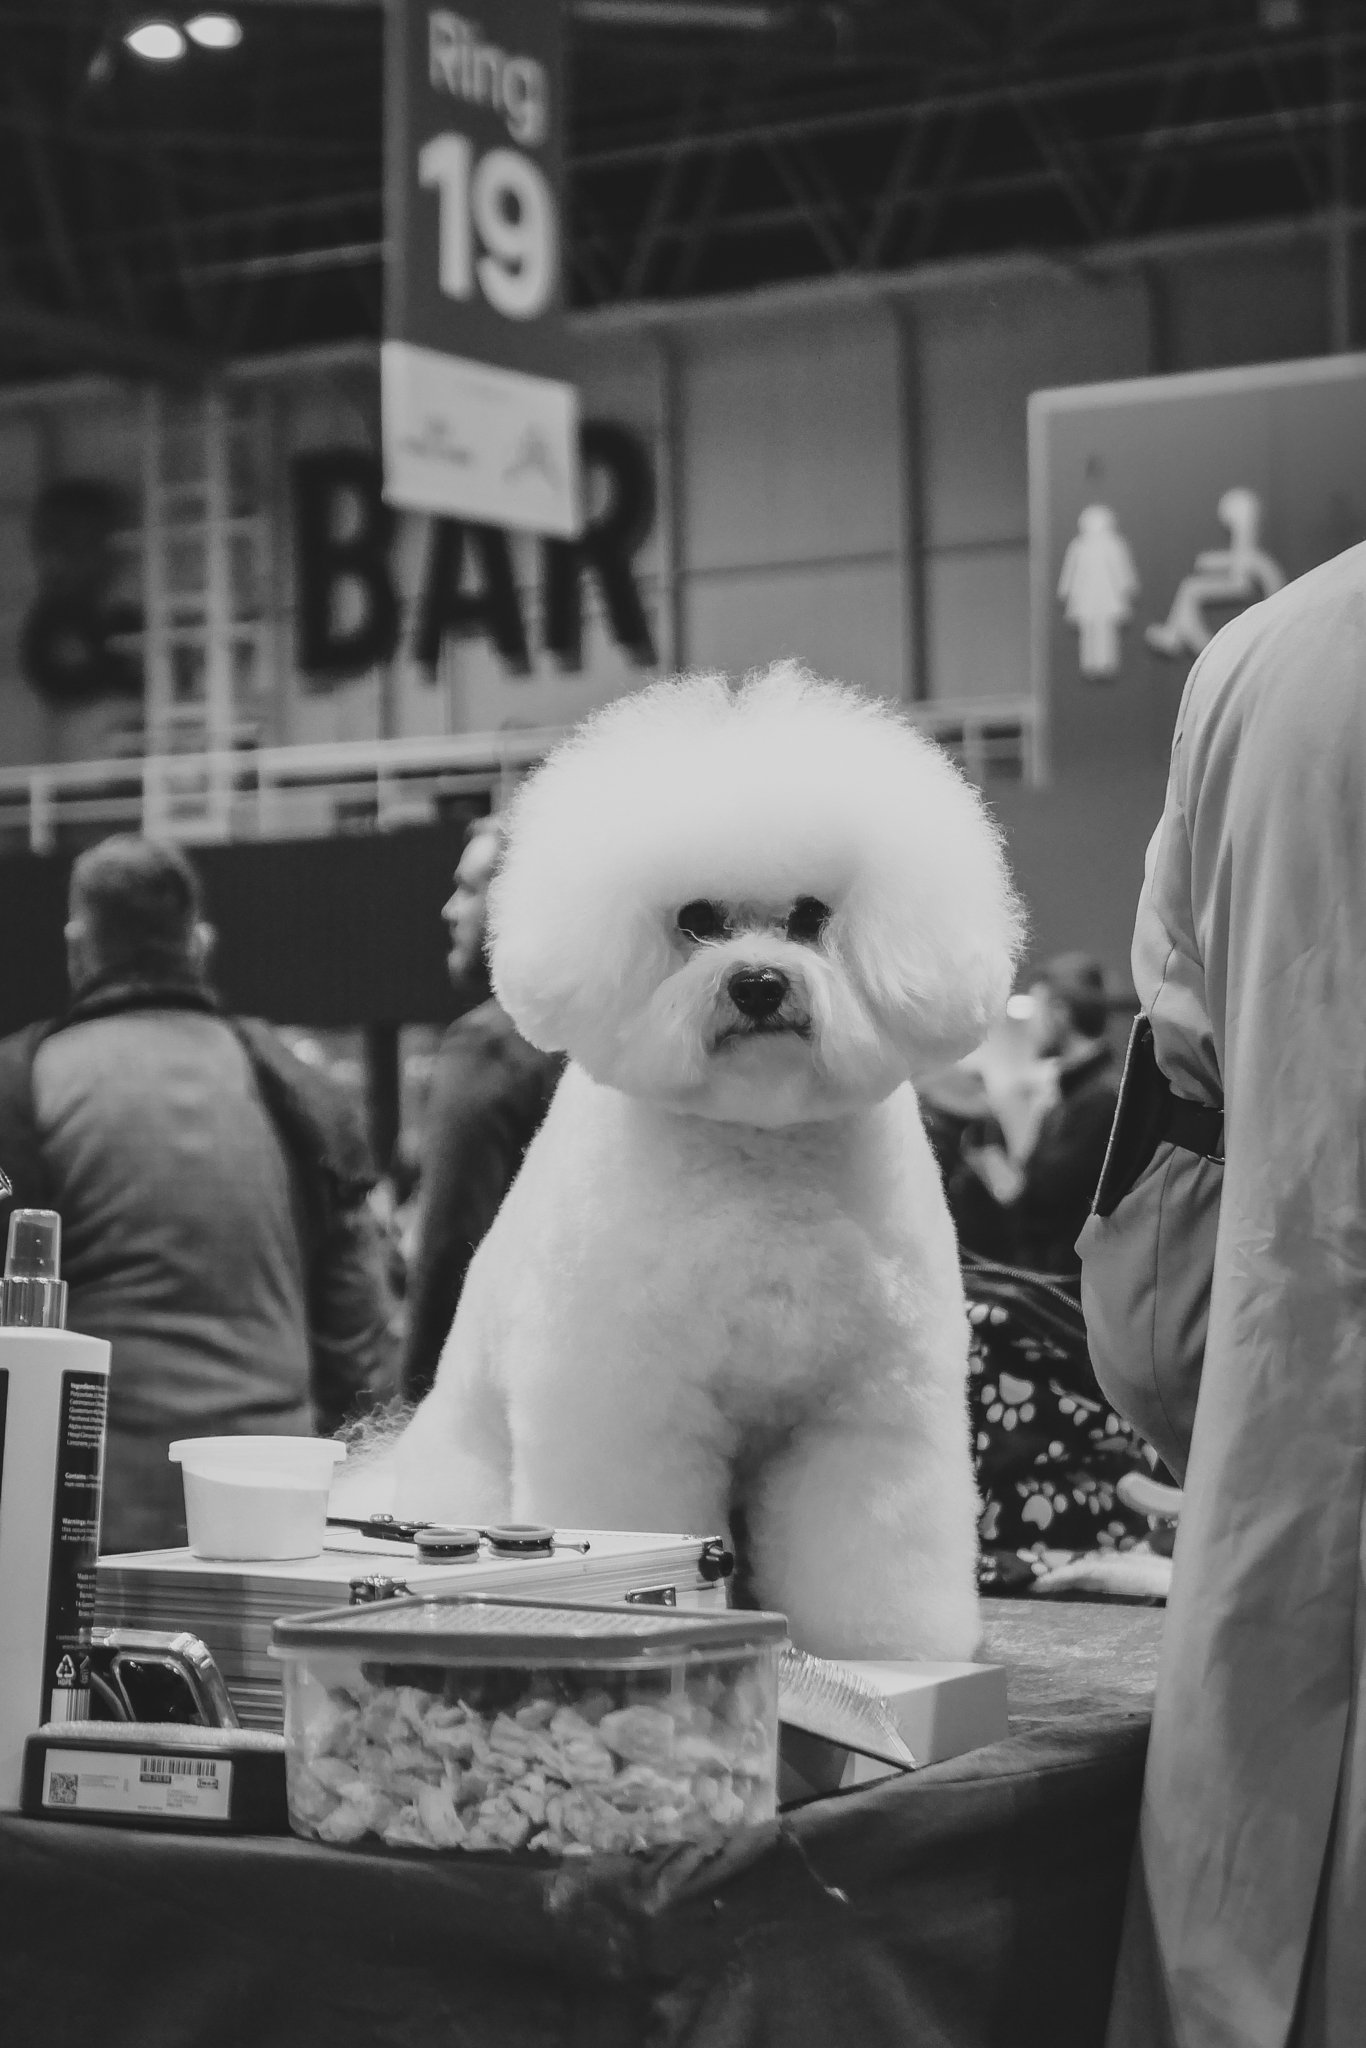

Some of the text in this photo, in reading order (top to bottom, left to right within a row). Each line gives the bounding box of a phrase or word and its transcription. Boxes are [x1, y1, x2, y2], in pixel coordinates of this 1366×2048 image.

[428, 9, 547, 147] Ring
[418, 131, 555, 321] 19
[293, 420, 658, 686] BAR
